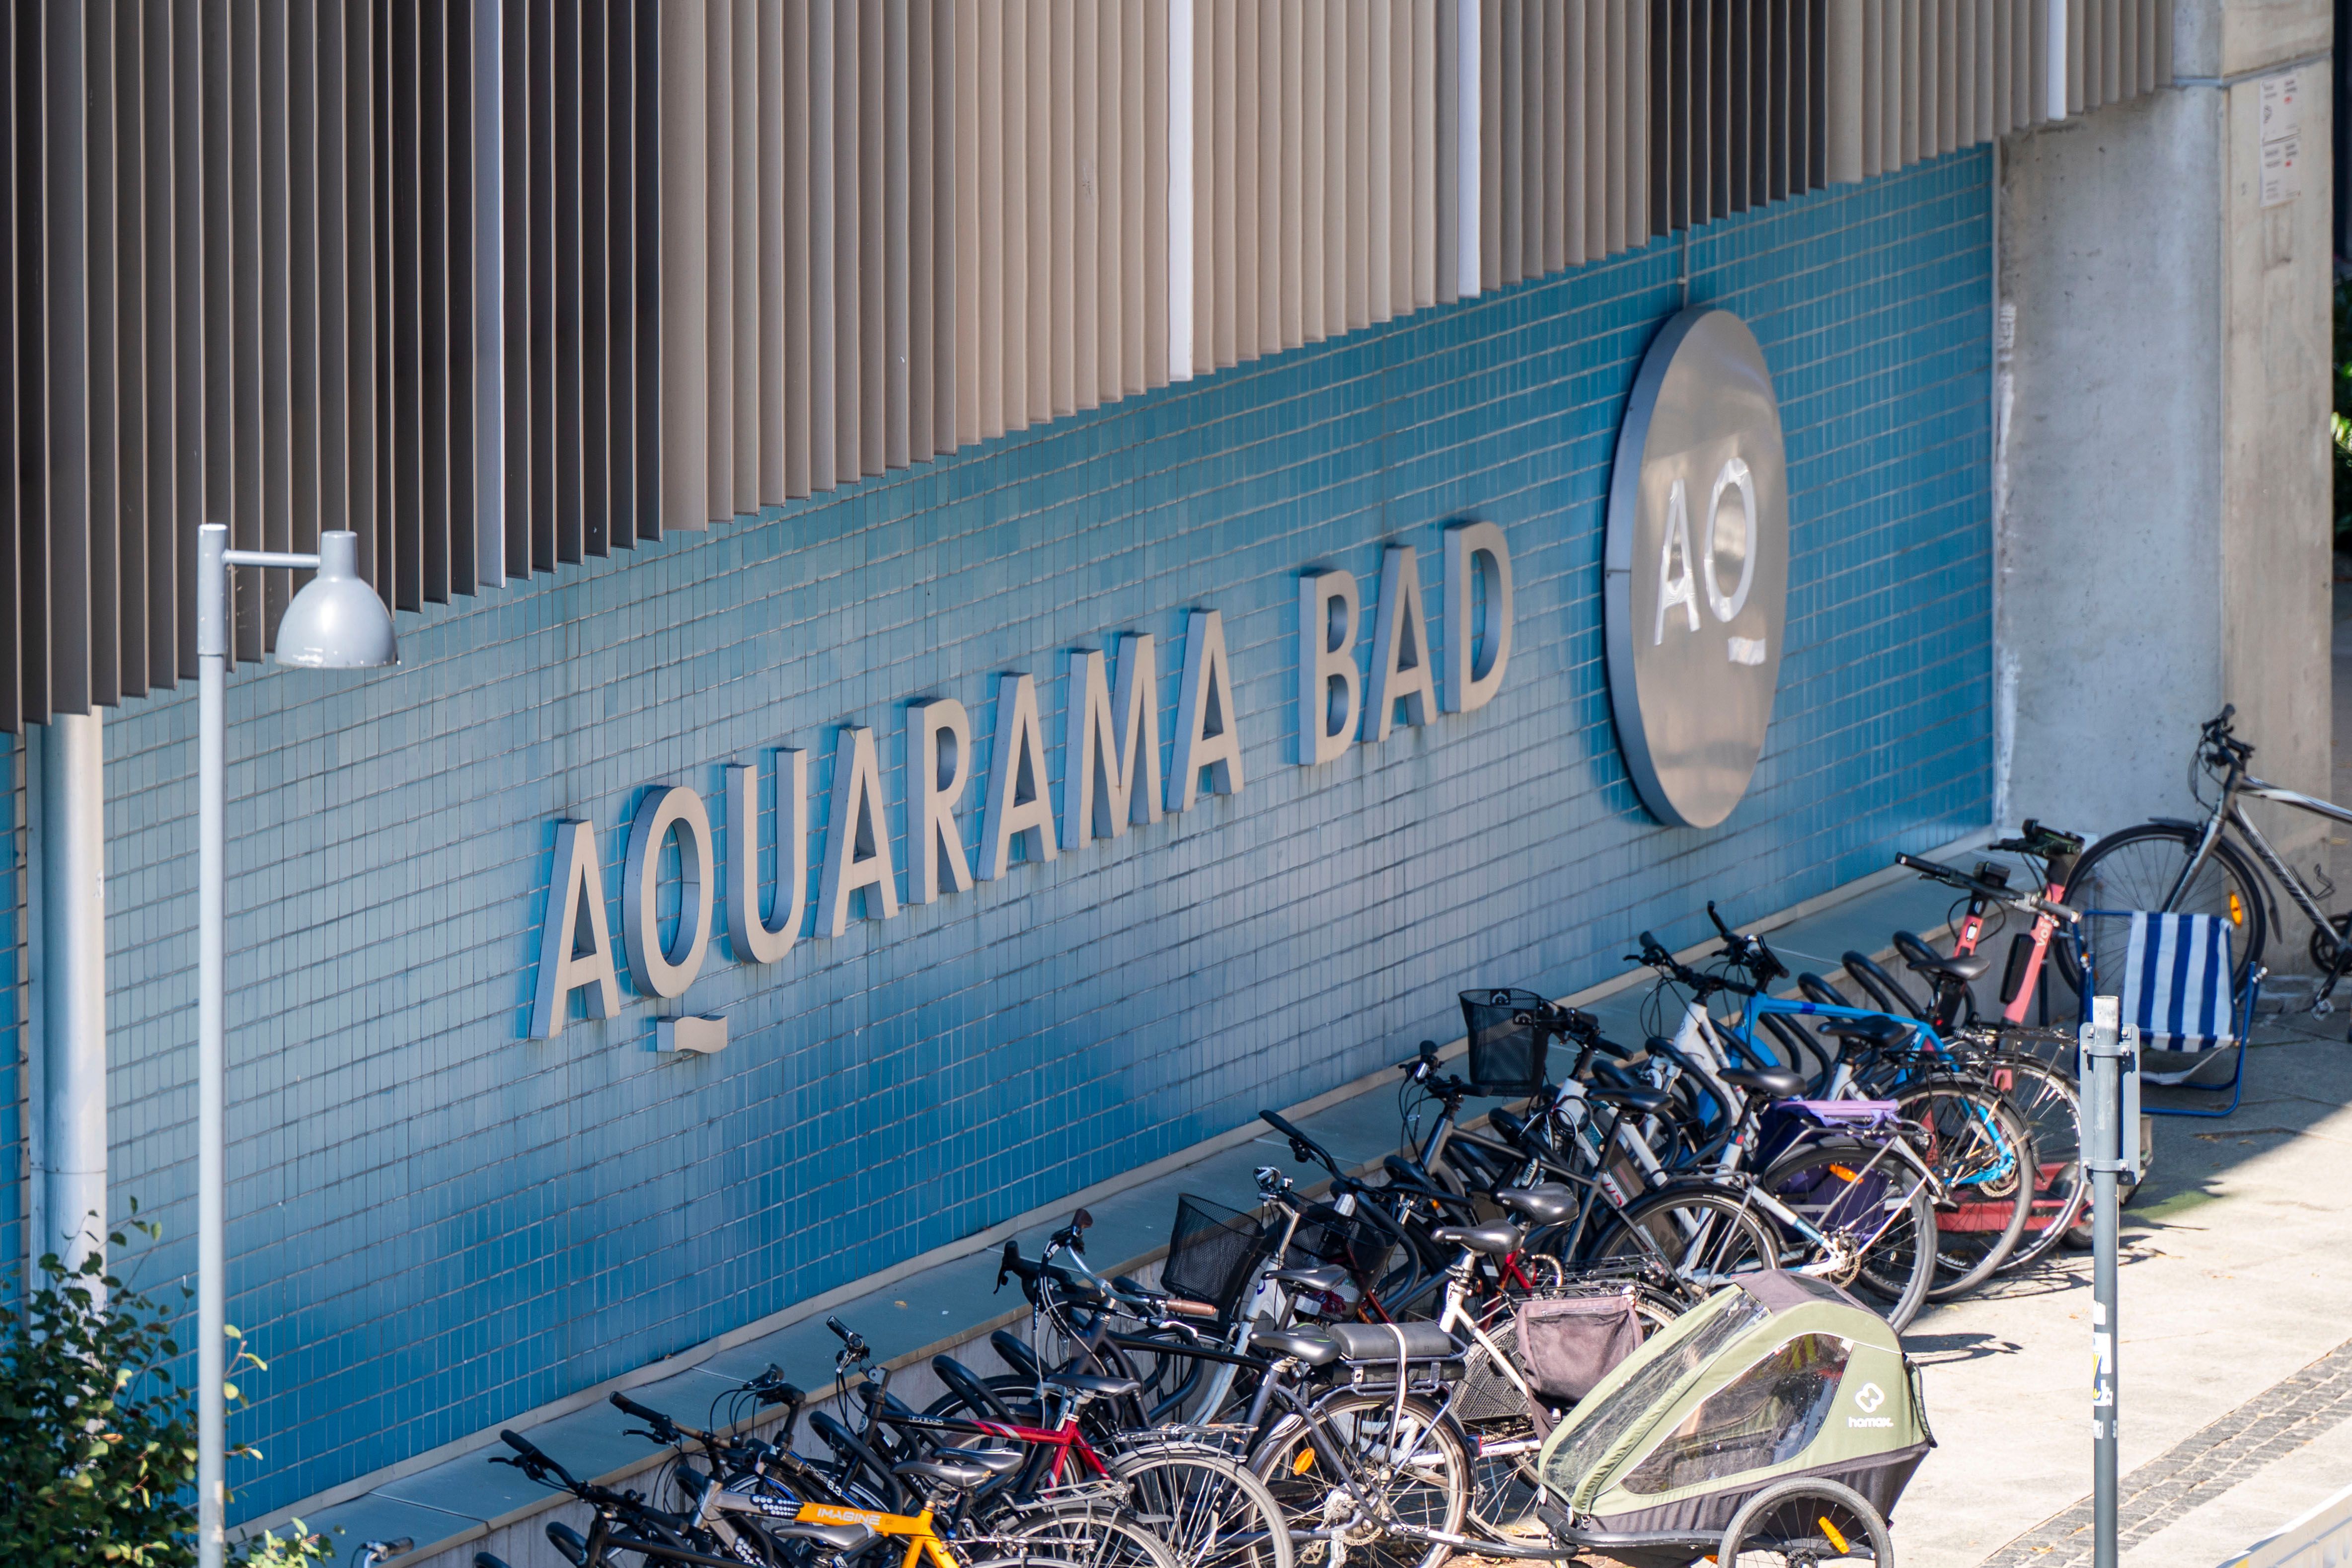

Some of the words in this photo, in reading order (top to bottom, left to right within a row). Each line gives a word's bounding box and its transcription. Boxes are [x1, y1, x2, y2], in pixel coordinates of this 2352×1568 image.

[528, 607, 1243, 1055] AQUARAMA
[1298, 521, 1514, 767] BAD
[2037, 921, 2051, 946] voi
[908, 1415, 944, 1426] DBS
[806, 1463, 829, 1484] CROSS
[817, 1507, 882, 1526] IMAGINE
